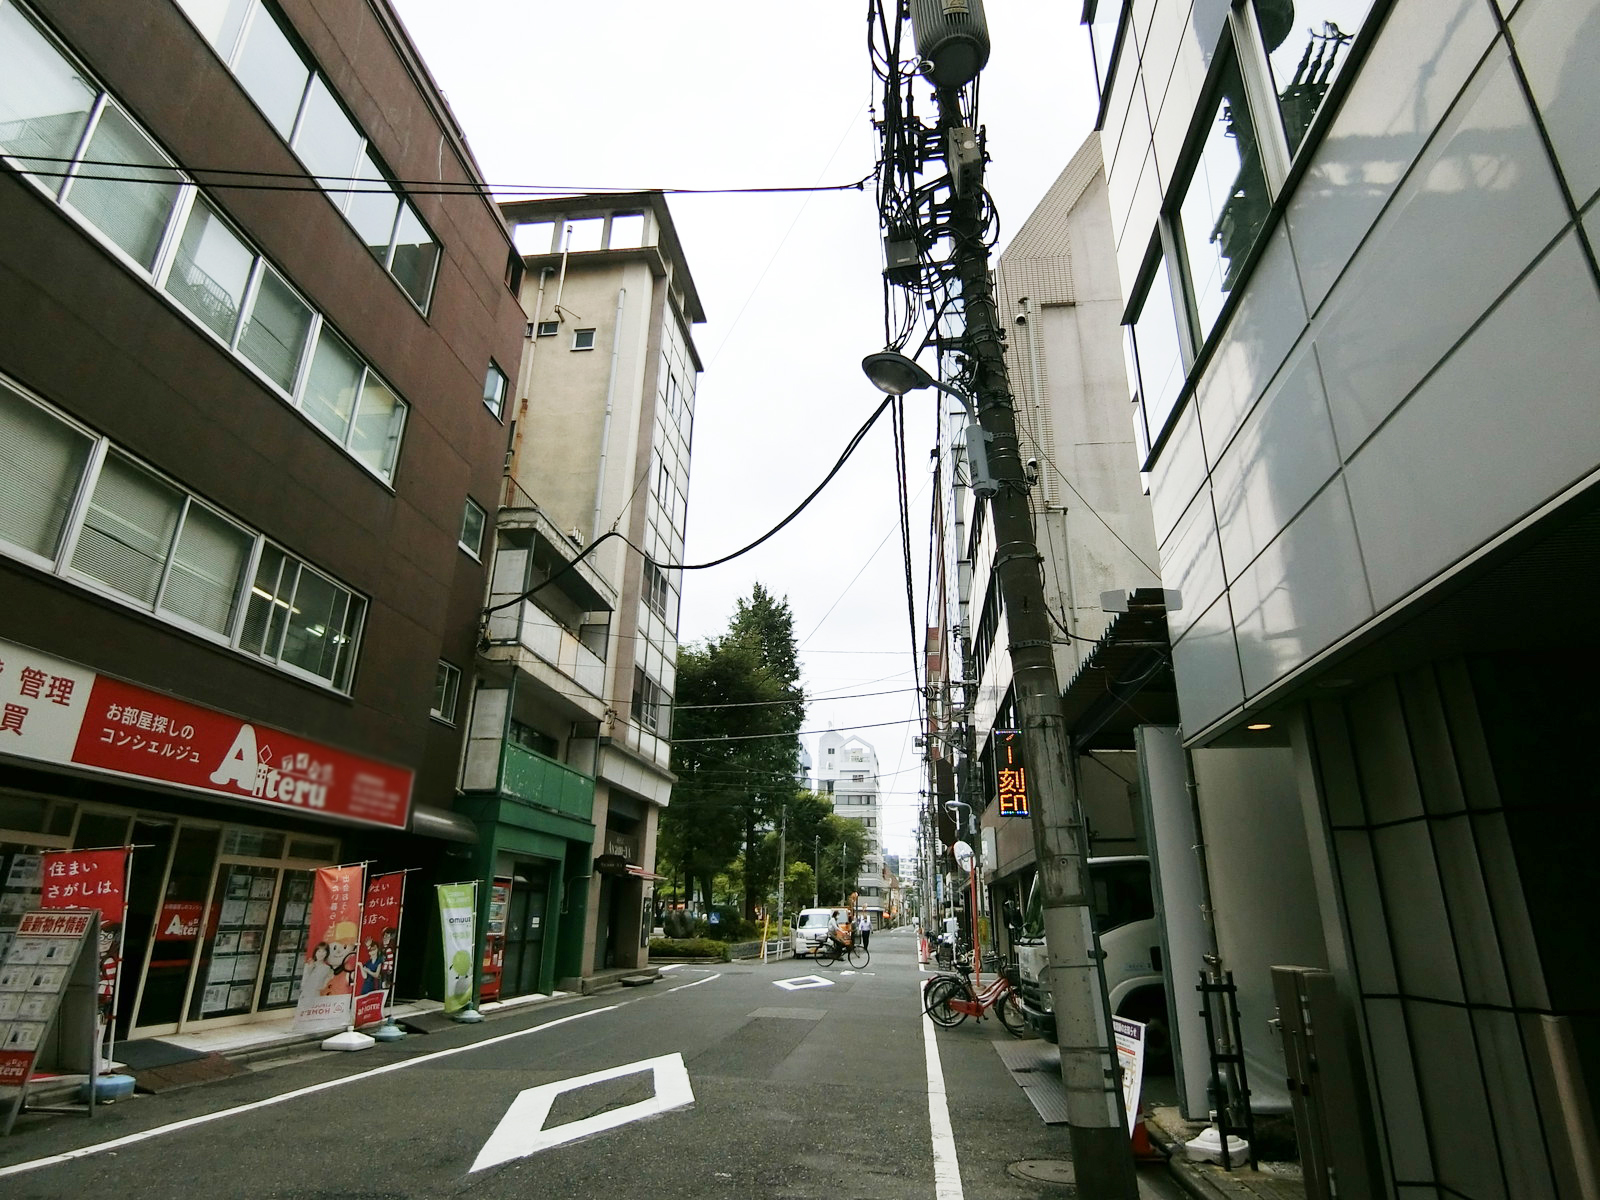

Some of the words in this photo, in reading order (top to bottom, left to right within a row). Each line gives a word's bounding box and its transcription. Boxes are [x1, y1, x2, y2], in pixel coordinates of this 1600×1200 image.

[20, 666, 75, 707] 管理
[106, 703, 195, 740] お部屋探しの
[100, 727, 200, 763] コンシェルジュ
[49, 861, 98, 877] 住まい
[47, 880, 119, 899] さがしは、
[20, 915, 89, 933] 最新物件情報
